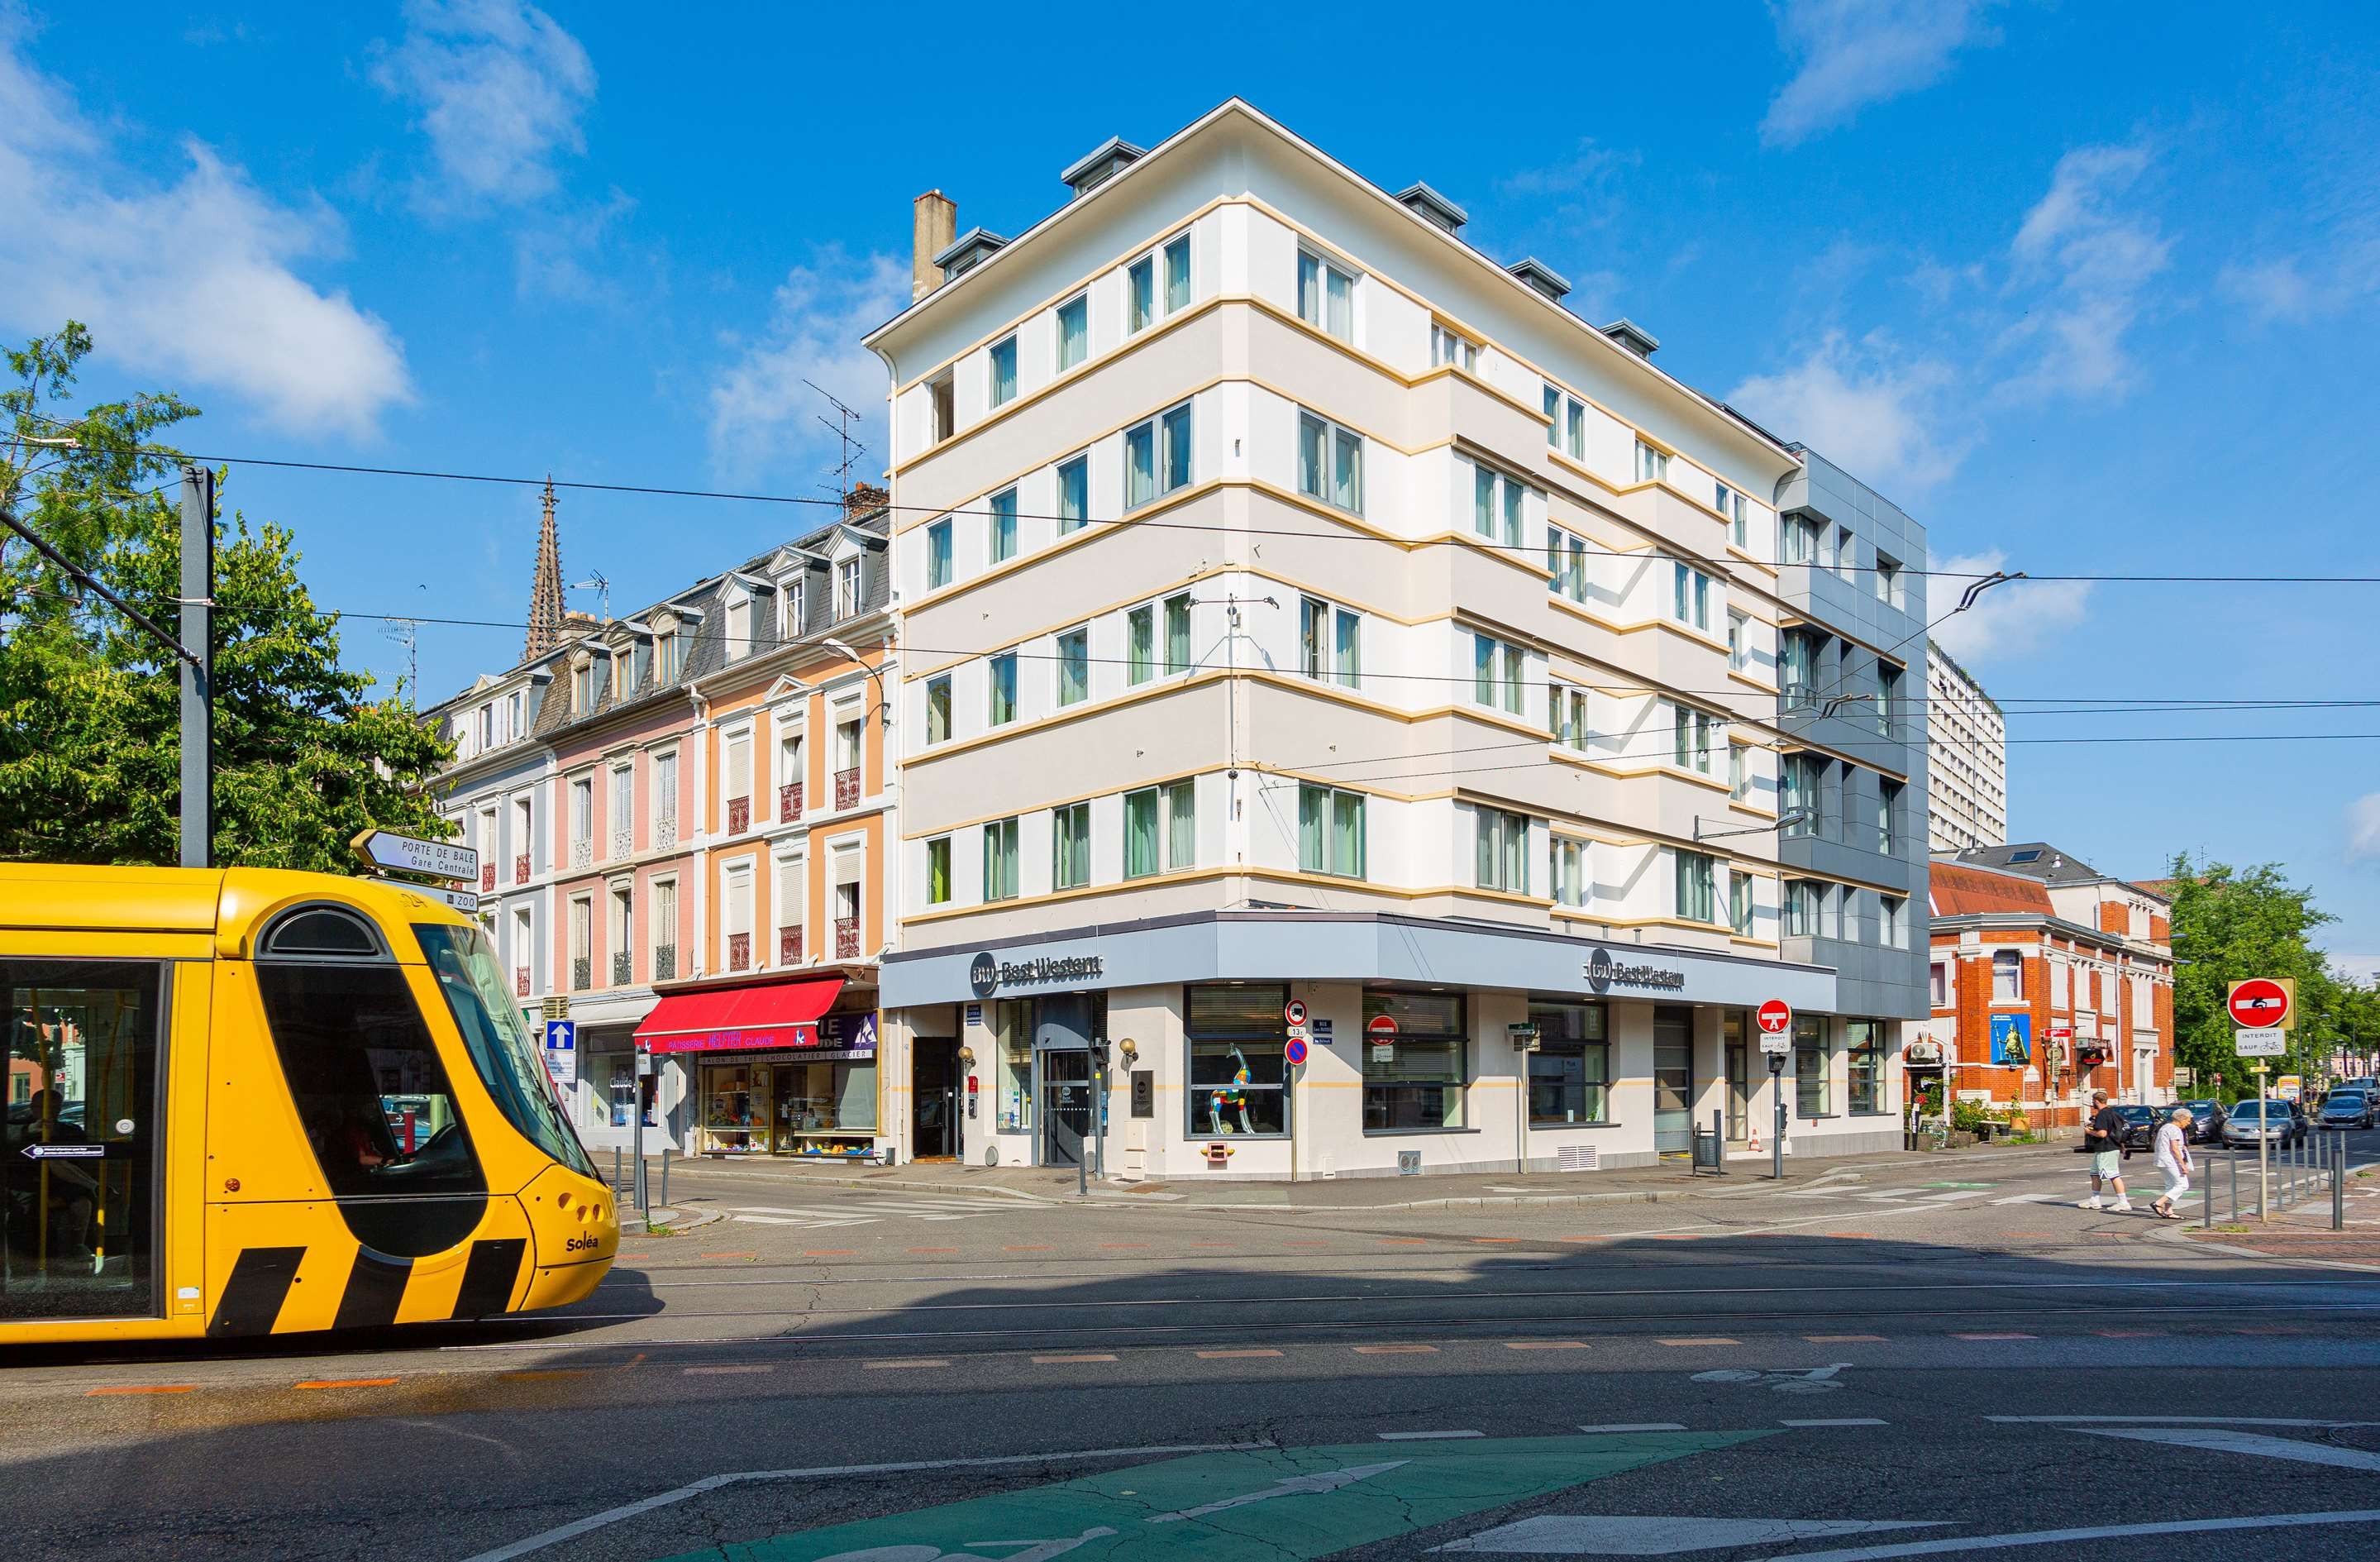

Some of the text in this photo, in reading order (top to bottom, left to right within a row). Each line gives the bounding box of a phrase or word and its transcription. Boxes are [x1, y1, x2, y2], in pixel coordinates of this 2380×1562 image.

[402, 841, 474, 863] PORTE DE BALE
[411, 856, 474, 875] Gare Centrale
[457, 896, 475, 907] ZOO
[972, 966, 996, 984] BW
[1001, 954, 1100, 981] Best Western
[1615, 962, 1685, 986] Best Western
[668, 1039, 705, 1051] PATISSERIE
[766, 1052, 821, 1062] CHOCOLATIER
[831, 1051, 866, 1059] GLACIER
[609, 1076, 632, 1088] Claude
[565, 1230, 599, 1252] Soléa
